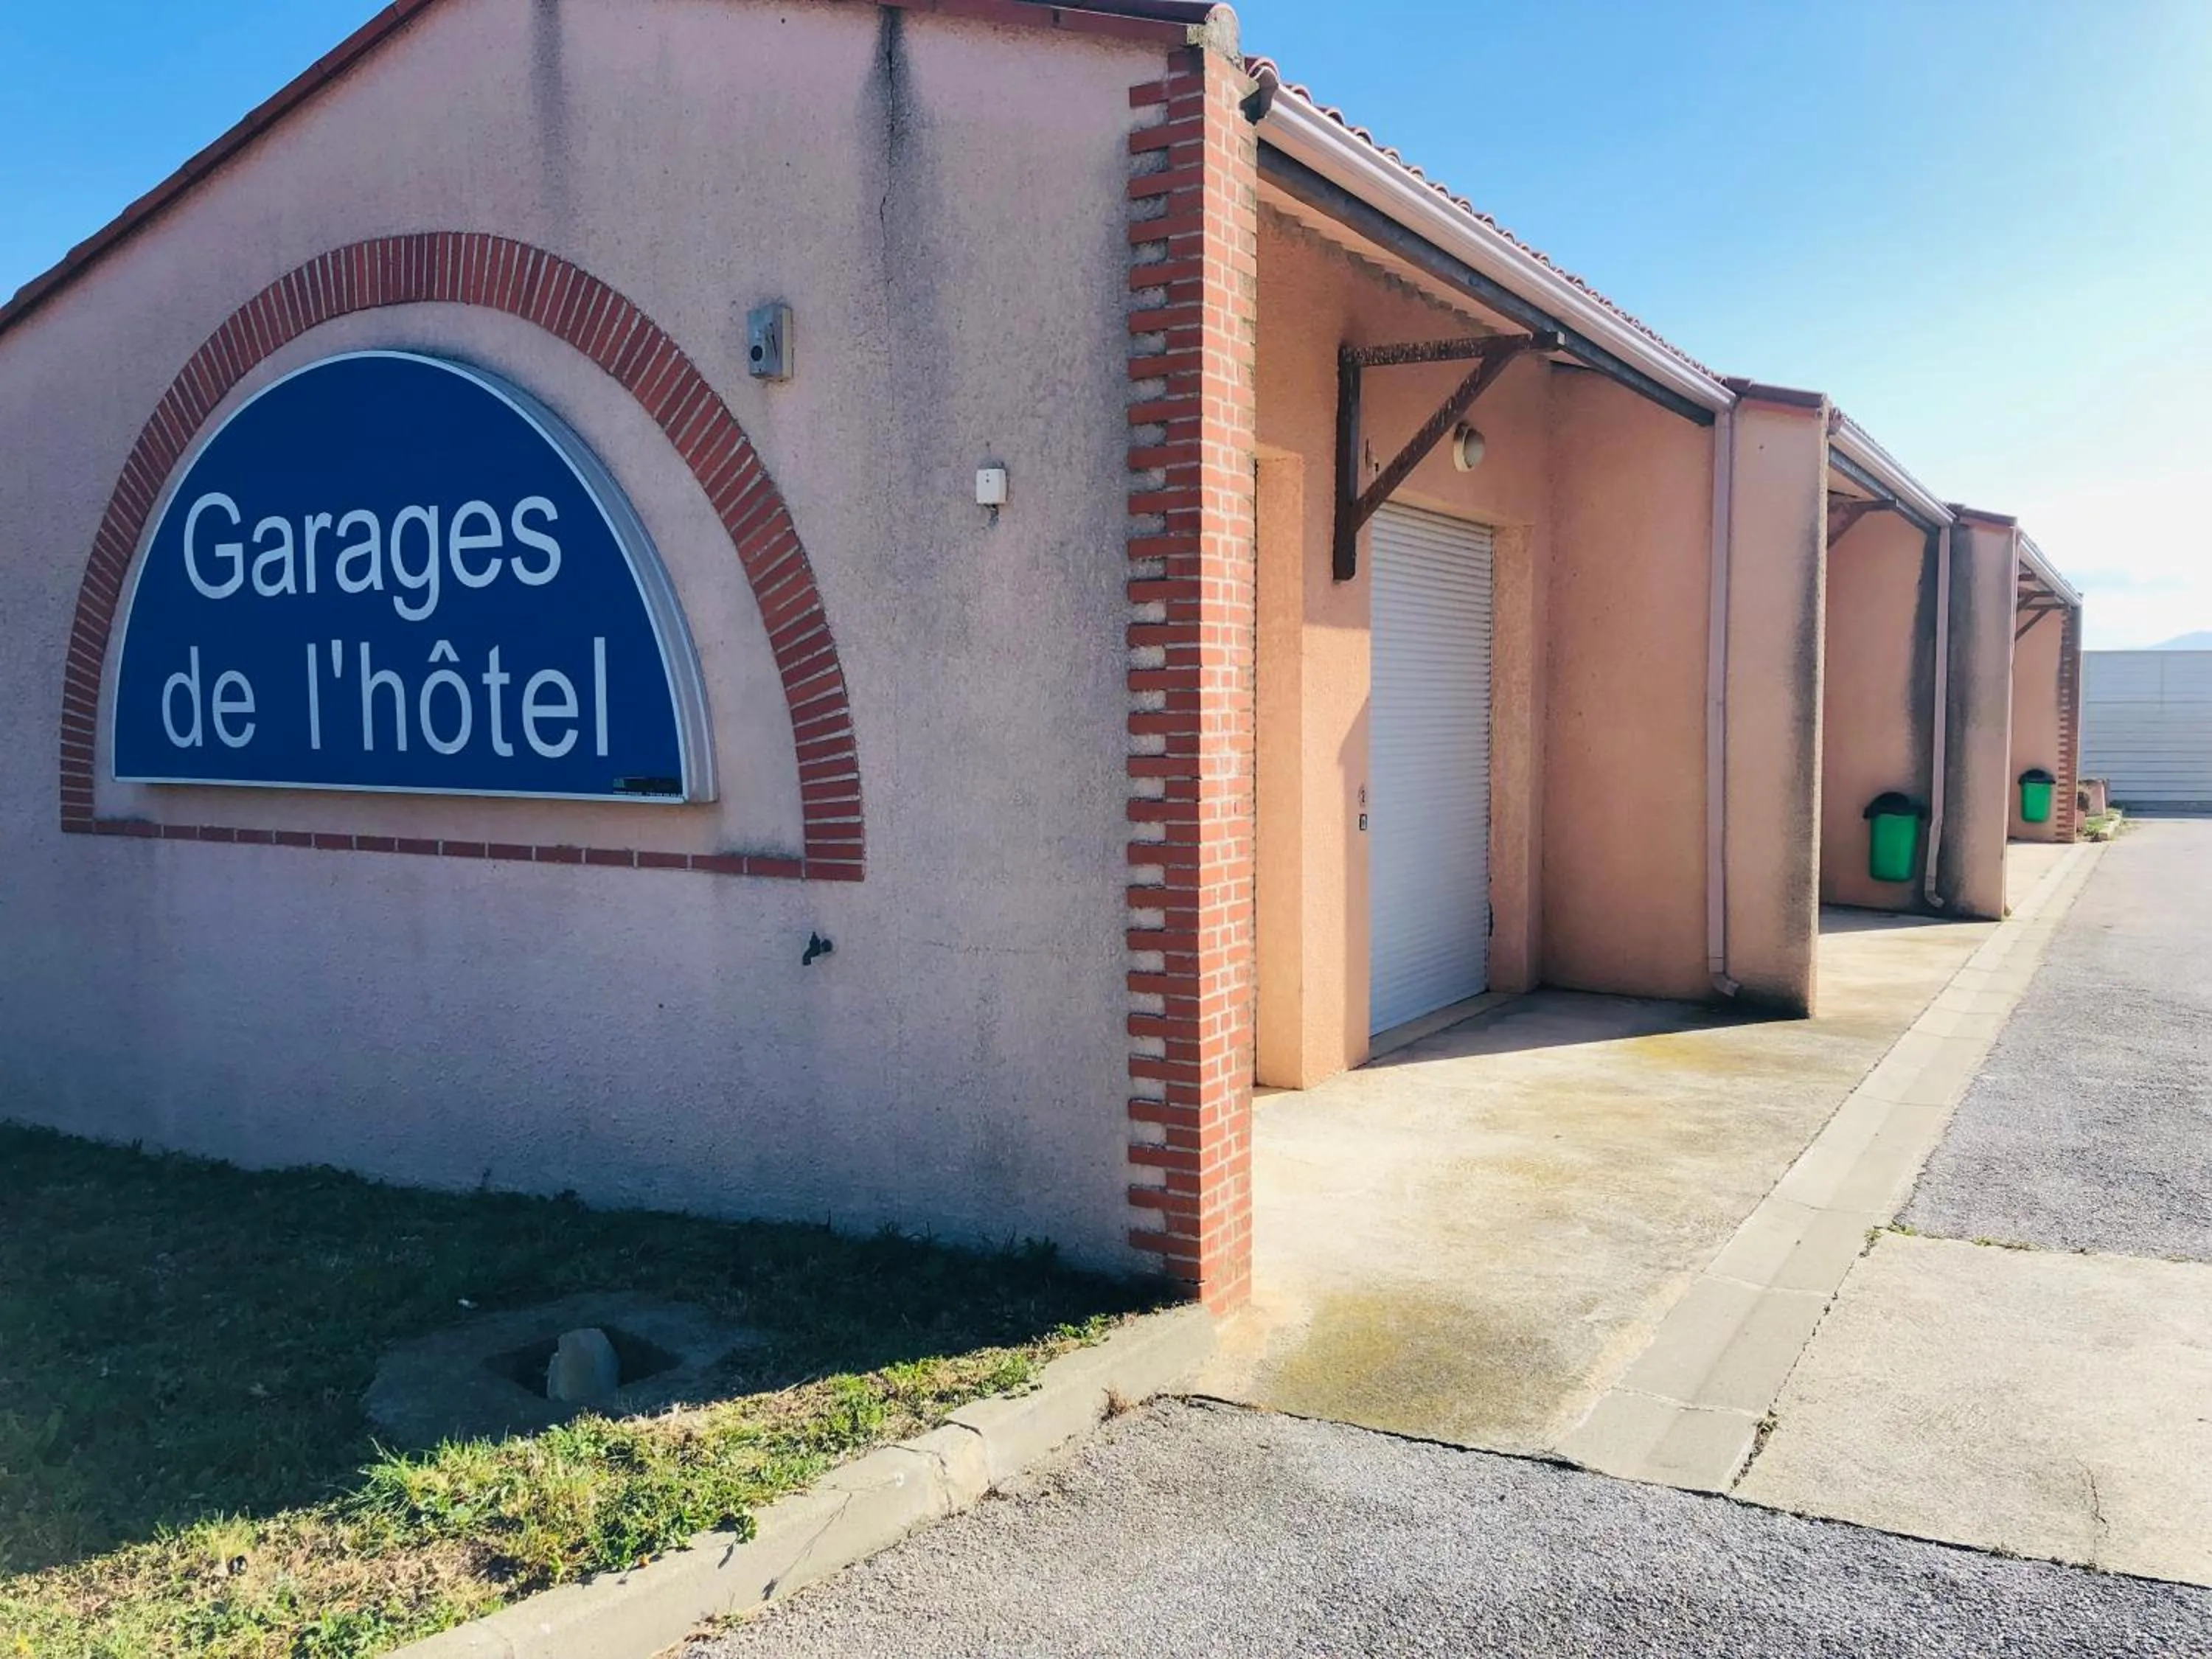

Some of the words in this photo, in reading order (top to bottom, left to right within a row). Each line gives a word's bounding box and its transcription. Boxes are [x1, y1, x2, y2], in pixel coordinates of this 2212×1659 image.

[183, 492, 563, 622] Garages
[161, 646, 257, 748] de
[306, 636, 610, 759] l'hôtel
